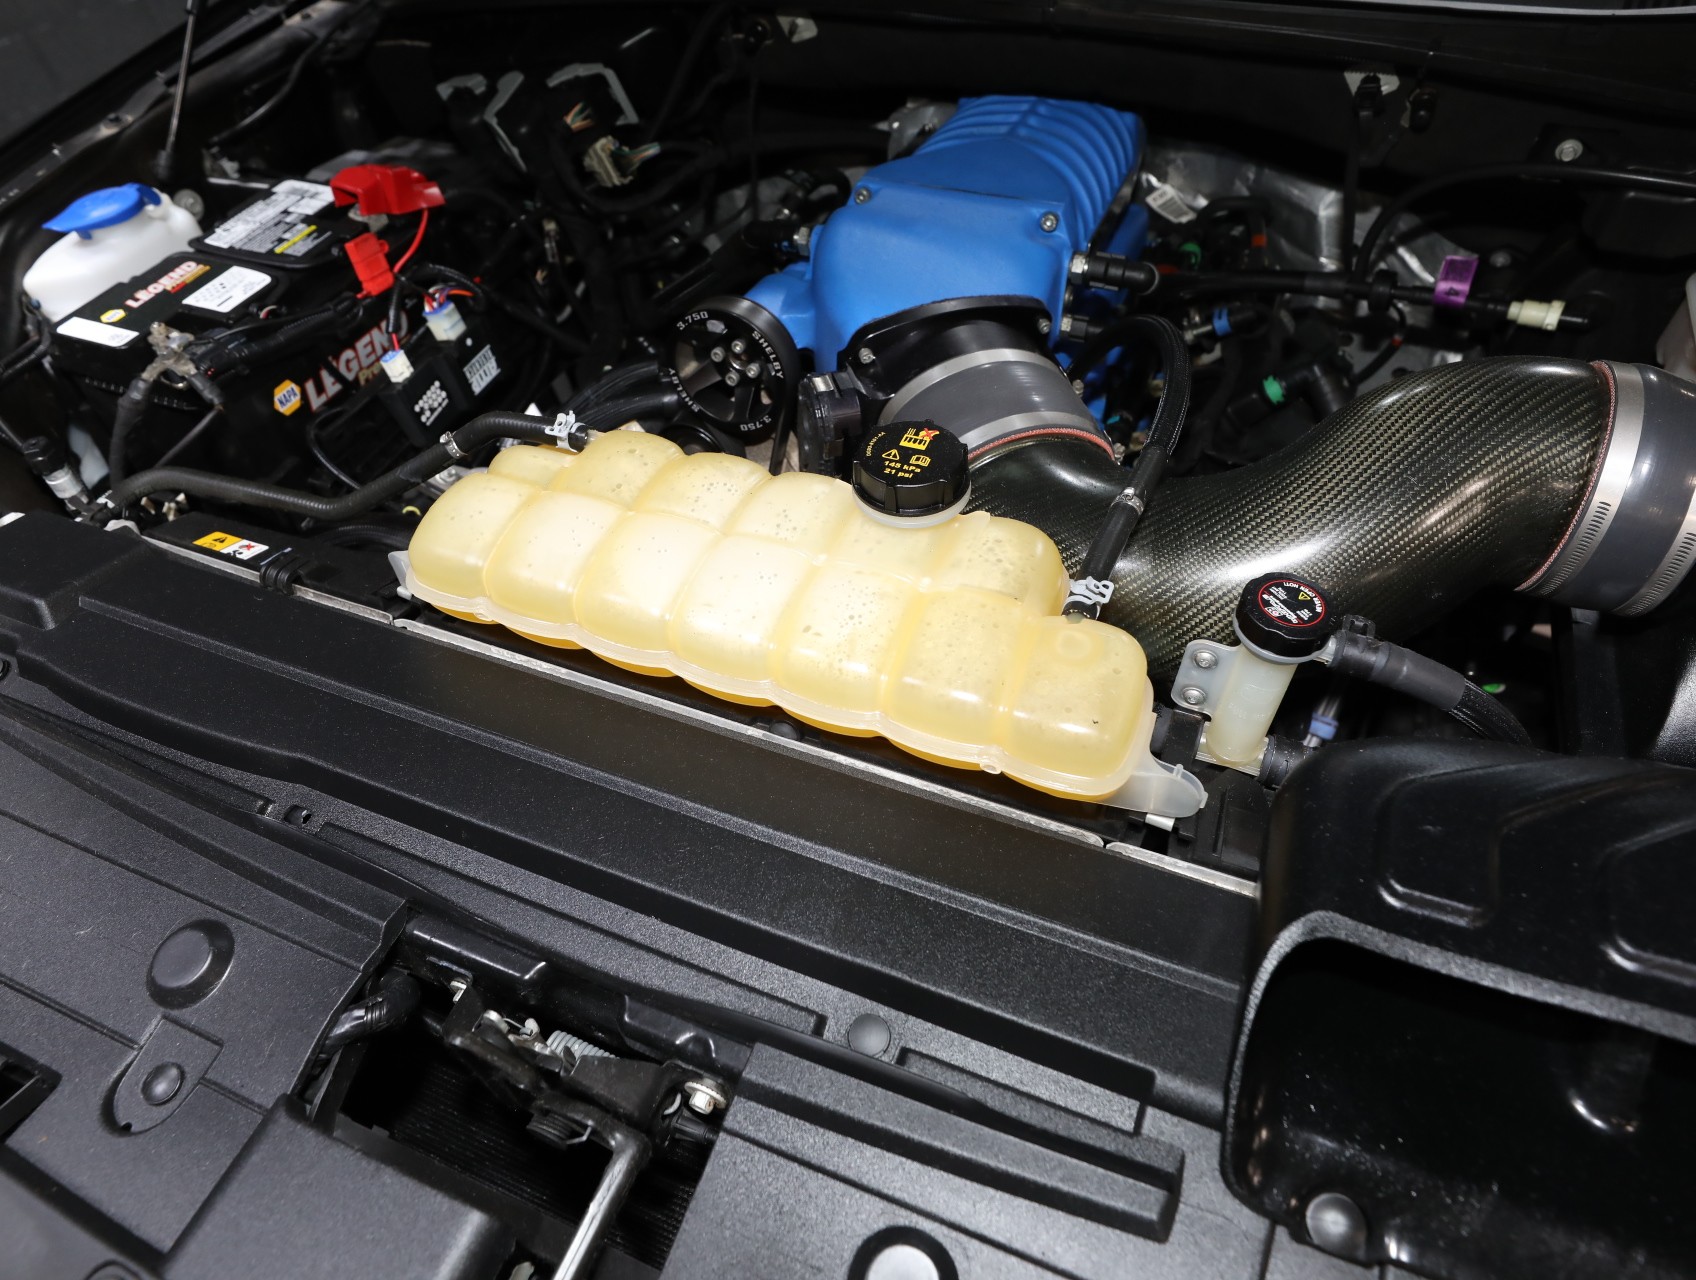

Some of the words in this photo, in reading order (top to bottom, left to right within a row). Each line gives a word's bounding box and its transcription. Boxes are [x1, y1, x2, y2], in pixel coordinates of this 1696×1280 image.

[124, 260, 198, 309] LEGEND
[676, 310, 709, 331] 3.750
[751, 330, 784, 379] SHELBY
[276, 386, 299, 409] NAPA
[668, 367, 701, 413] SHELBY
[739, 414, 772, 432] 3.750
[884, 460, 902, 469] 145
[902, 464, 921, 473] kPa
[884, 467, 896, 475] 21
[897, 471, 914, 479] psi
